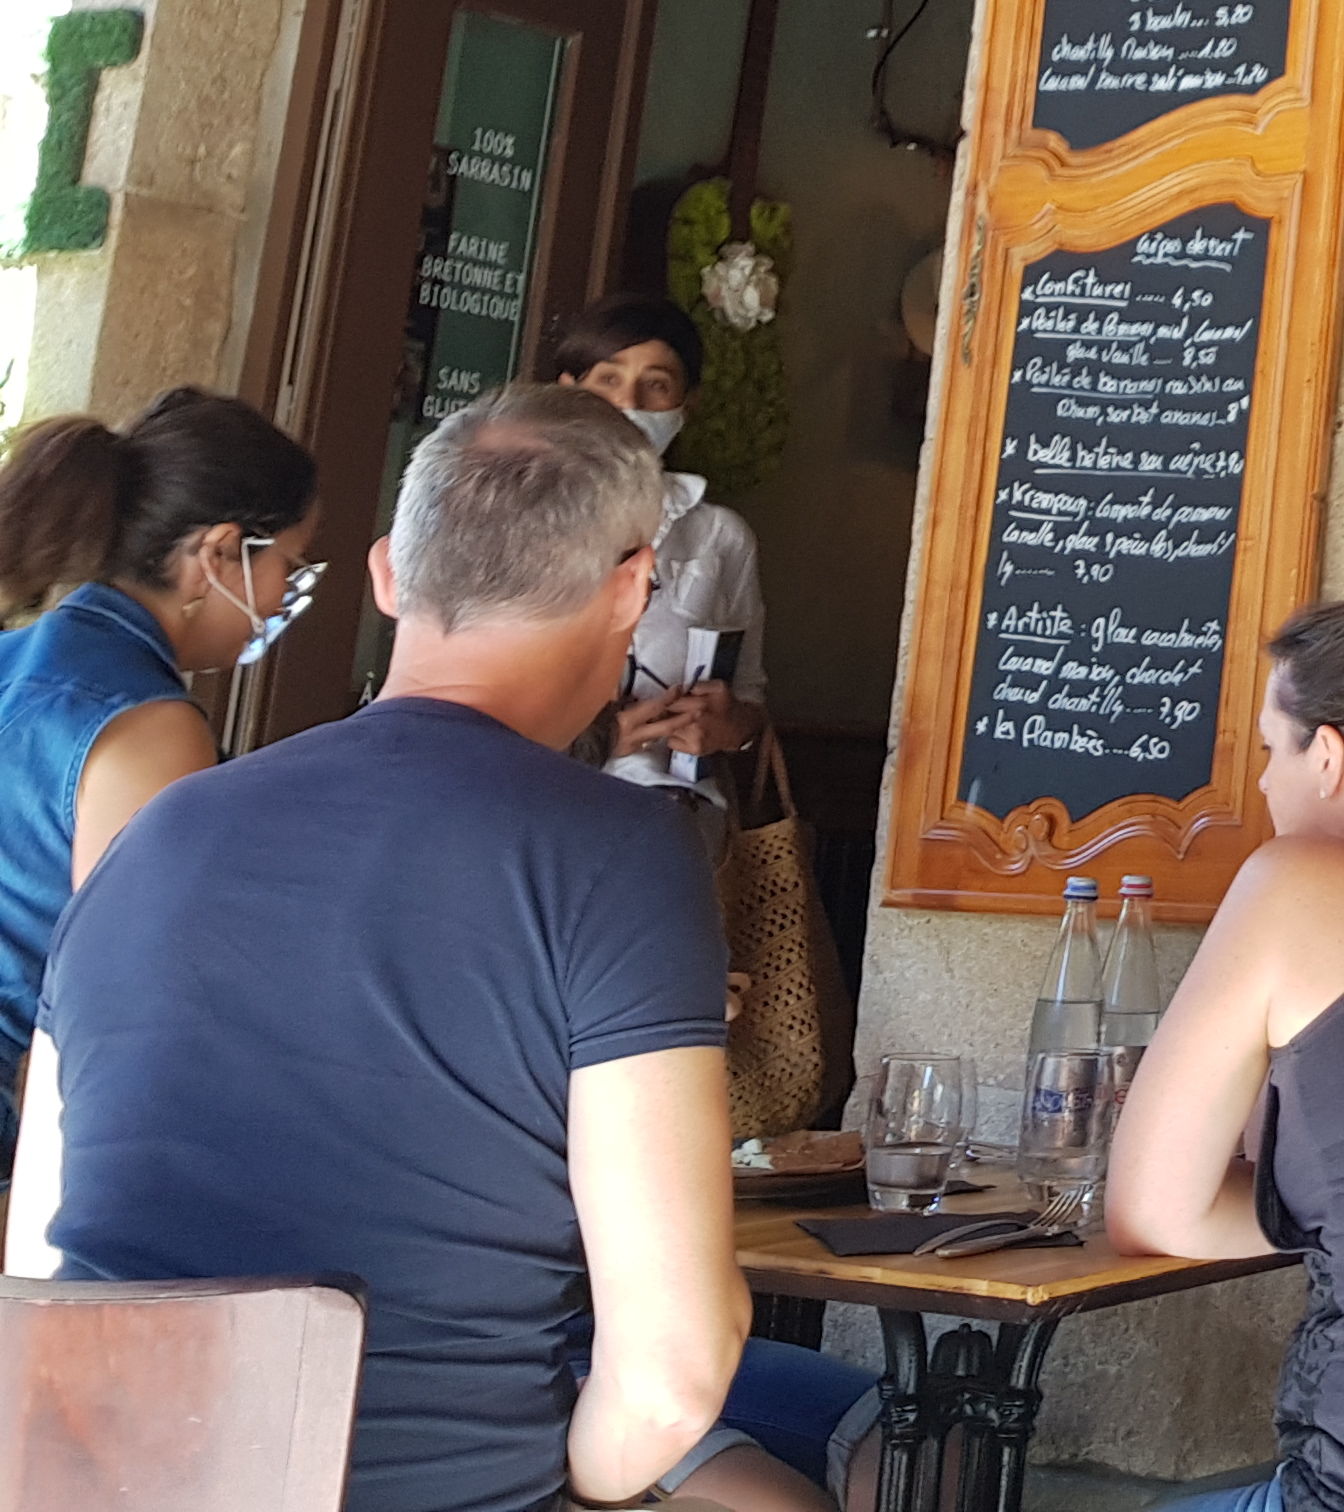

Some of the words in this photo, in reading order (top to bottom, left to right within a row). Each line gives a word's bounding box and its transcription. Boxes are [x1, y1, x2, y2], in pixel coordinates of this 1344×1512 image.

[472, 127, 516, 158] 100%
[447, 150, 533, 192] SARRASIN
[448, 230, 510, 265] FARINE
[420, 254, 505, 291] BRETONNE
[419, 281, 521, 321] BIOLOGIQUE
[1081, 310, 1100, 336] de
[437, 366, 481, 394] SANS
[1072, 365, 1093, 389] de
[1151, 493, 1175, 522] de
[993, 674, 1048, 704] chaud
[1128, 734, 1171, 762] 6,50
